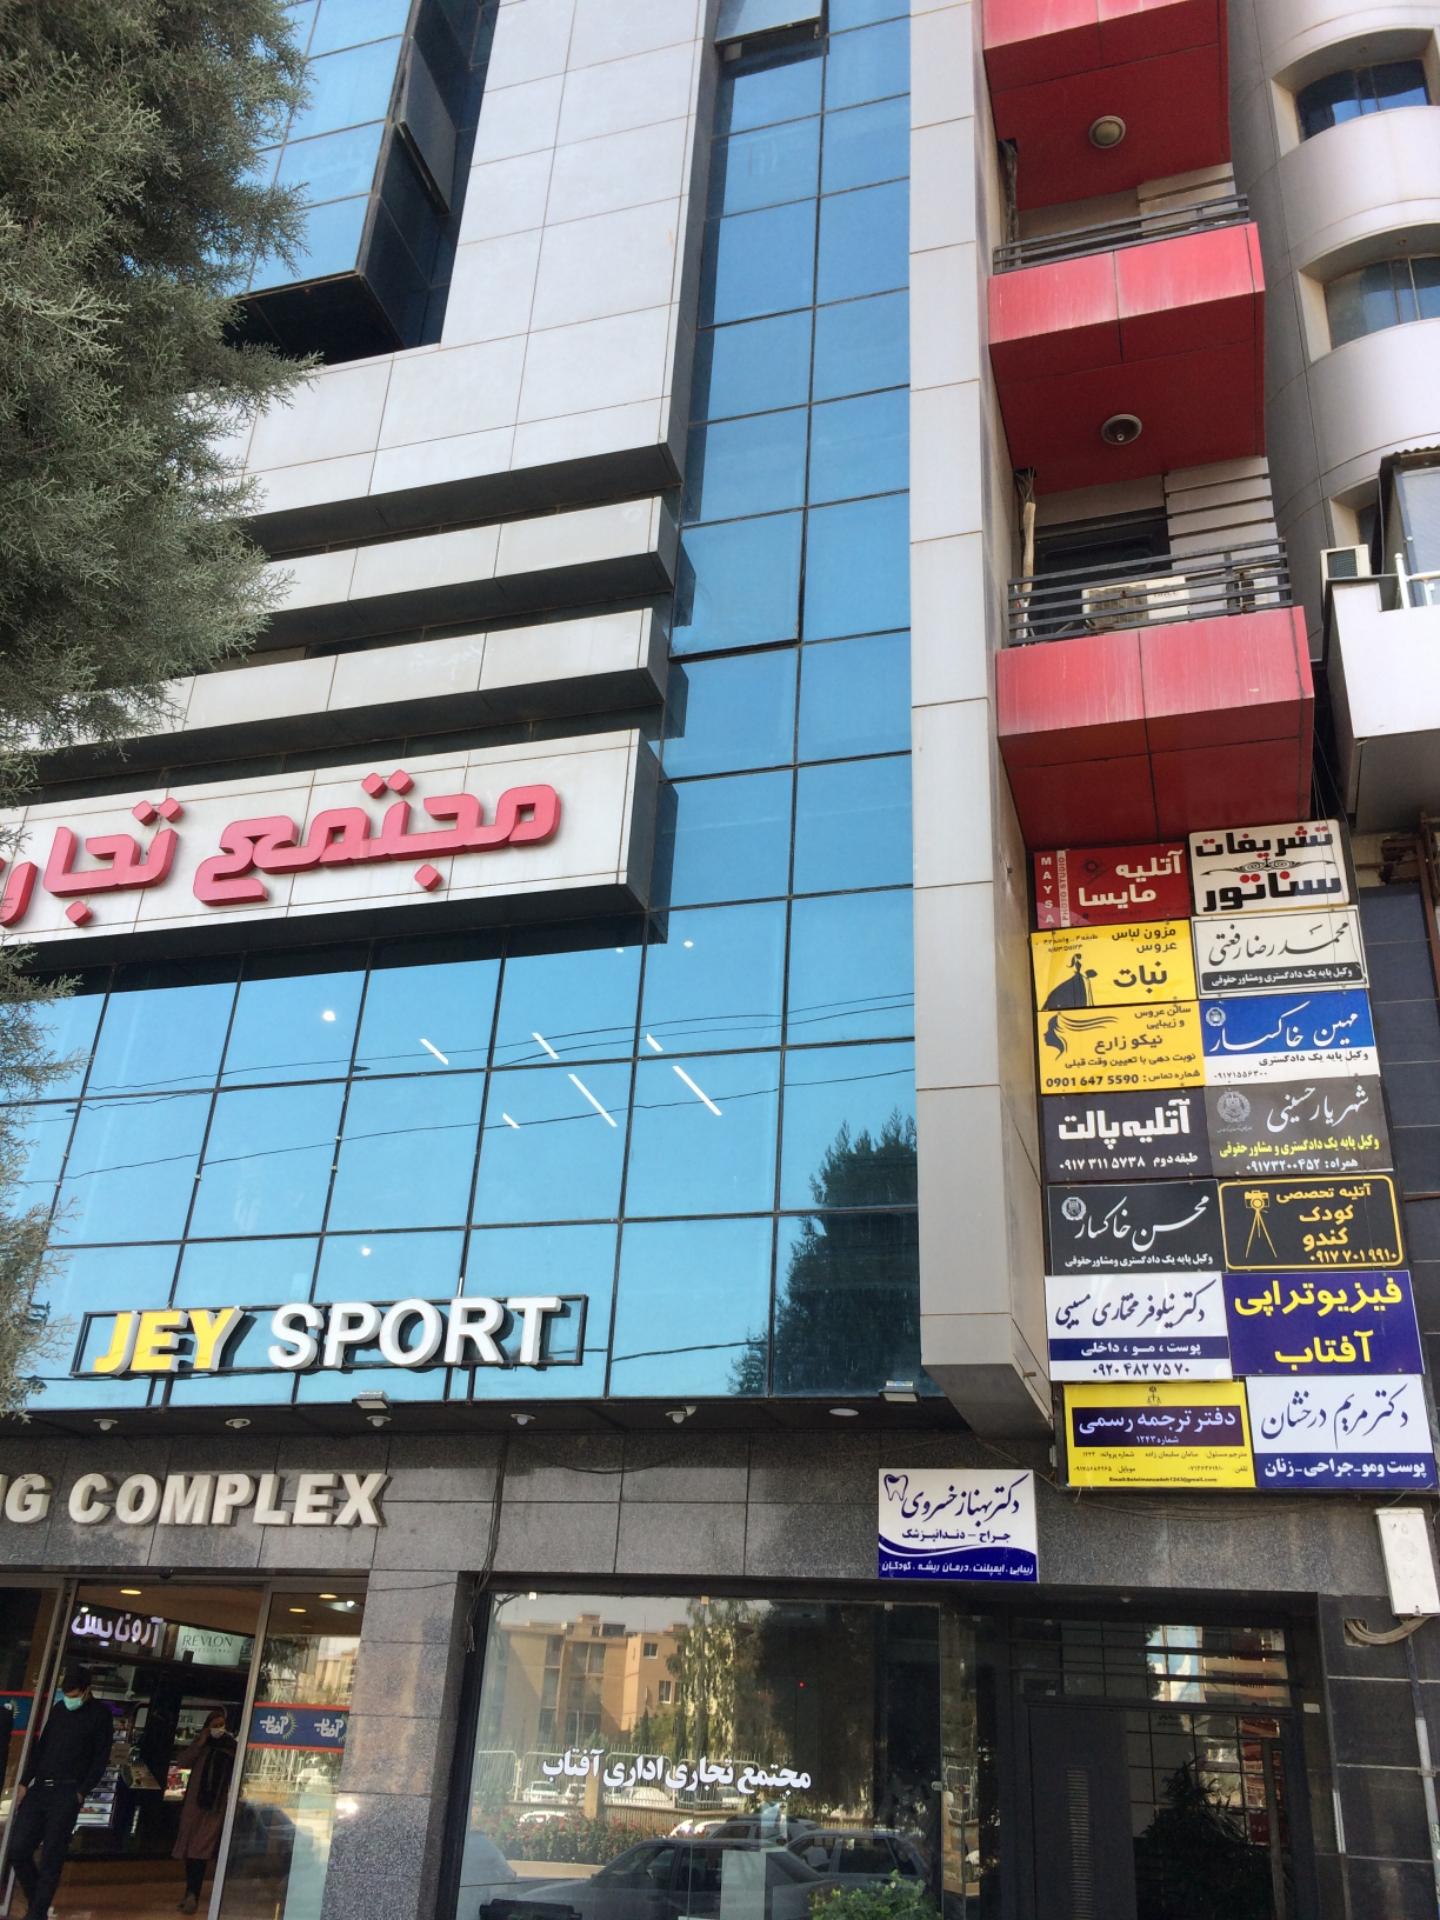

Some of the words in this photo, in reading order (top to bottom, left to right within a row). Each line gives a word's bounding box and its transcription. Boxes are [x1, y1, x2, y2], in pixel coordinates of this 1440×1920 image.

[193, 769, 563, 907] مجتمع
[1195, 826, 1333, 858] تشریفات
[0, 797, 184, 928] تجار
[1115, 850, 1183, 882] آتلیه
[1041, 857, 1054, 924] MAYSA
[1078, 884, 1157, 909] مایسا
[1203, 871, 1341, 912] سناتور
[1111, 928, 1140, 942] لباس
[1144, 926, 1177, 939] مزون
[1278, 922, 1350, 955] محمد
[1136, 941, 1177, 954] عروس
[1247, 936, 1275, 958] رضا
[1113, 960, 1168, 994] نبات
[1264, 970, 1303, 983] دادگستری
[1303, 969, 1317, 979] یک
[1317, 968, 1332, 979] پایه
[1333, 967, 1353, 979] وکیل
[1211, 976, 1237, 987] حقوقی
[1134, 1008, 1165, 1019] عروس
[1167, 1003, 1191, 1016] سالن
[1146, 1019, 1177, 1030] زیبایی
[1209, 1000, 1311, 1052] خاکسار
[1313, 1012, 1359, 1047] مهین
[1094, 1037, 1127, 1054] زارع
[1131, 1034, 1163, 1050] نیکو
[1065, 1059, 1086, 1069] قبلی
[1149, 1055, 1170, 1065] دهی
[1172, 1053, 1196, 1062] نوبت
[1258, 1054, 1306, 1067] دادگستری
[1307, 1052, 1323, 1062] یک
[1325, 1052, 1343, 1062] پایه
[1345, 1050, 1369, 1062] وکیل
[1046, 1077, 1077, 1088] 0901
[1080, 1076, 1103, 1087] 647
[1107, 1074, 1139, 1085] 5590
[1174, 1069, 1200, 1081] شماره
[1266, 1086, 1316, 1133] حسینی
[1122, 1098, 1191, 1143] آتلیه
[1058, 1110, 1121, 1150] پالت
[1219, 1140, 1248, 1158] حقوقی
[1280, 1137, 1322, 1154] دادگستری
[1324, 1137, 1338, 1151] یک
[1340, 1136, 1357, 1151] پایه
[1357, 1134, 1380, 1150] وکیل
[1059, 1159, 1086, 1171] ۰۹۱۷
[1152, 1154, 1173, 1167] دوم
[1174, 1152, 1199, 1166] طبقه
[1339, 1183, 1371, 1200] آتلیه
[1074, 1195, 1132, 1239] خاکسار
[1299, 1205, 1354, 1225] کودک
[1131, 1195, 1210, 1252] محسن
[1302, 1227, 1350, 1251] کندو
[1064, 1256, 1095, 1268] حقوقی
[1120, 1254, 1161, 1267] دادگستری
[1161, 1255, 1176, 1266] یک
[1176, 1254, 1192, 1266] پایه
[1192, 1253, 1214, 1265] وکیل
[1309, 1250, 1340, 1263] ۰۹۱۷
[1343, 1250, 1366, 1262] ۷۰۱
[1368, 1248, 1397, 1262] ۹۹۱۰
[1173, 1279, 1217, 1326] دکتر
[1234, 1277, 1403, 1317] فیزیوتراپی
[1092, 1293, 1140, 1327] مختاری
[1137, 1293, 1176, 1329] نیلوفر
[92, 1306, 244, 1375] JEY
[268, 1297, 562, 1370] SPORT
[1080, 1342, 1120, 1356] داخلی
[1274, 1330, 1374, 1371] آفتاب
[1093, 1364, 1120, 1376] ۰۹۲۰
[1260, 1390, 1327, 1439] درخشان
[1362, 1383, 1409, 1436] دکتر
[1079, 1415, 1134, 1434] رسمی
[1137, 1409, 1193, 1433] ترجمه
[1193, 1407, 1236, 1433] دفتر
[1333, 1393, 1369, 1450] مریم
[1157, 1435, 1180, 1446] شماره
[1387, 1460, 1428, 1478] پوست
[68, 1472, 390, 1526] COMPLEX
[901, 1484, 958, 1522] خسروی
[984, 1473, 1030, 1522] دکتر
[901, 1528, 966, 1542] دندانپزشک
[979, 1530, 1011, 1543] جراح
[881, 1561, 912, 1571] کودکان
[917, 1560, 940, 1573] ریشه
[942, 1562, 969, 1573] درمان
[542, 1748, 605, 1782] آفتاب
[603, 1755, 664, 1788] اداری
[665, 1757, 734, 1791] تجاری
[736, 1764, 811, 1795] مجتمع
